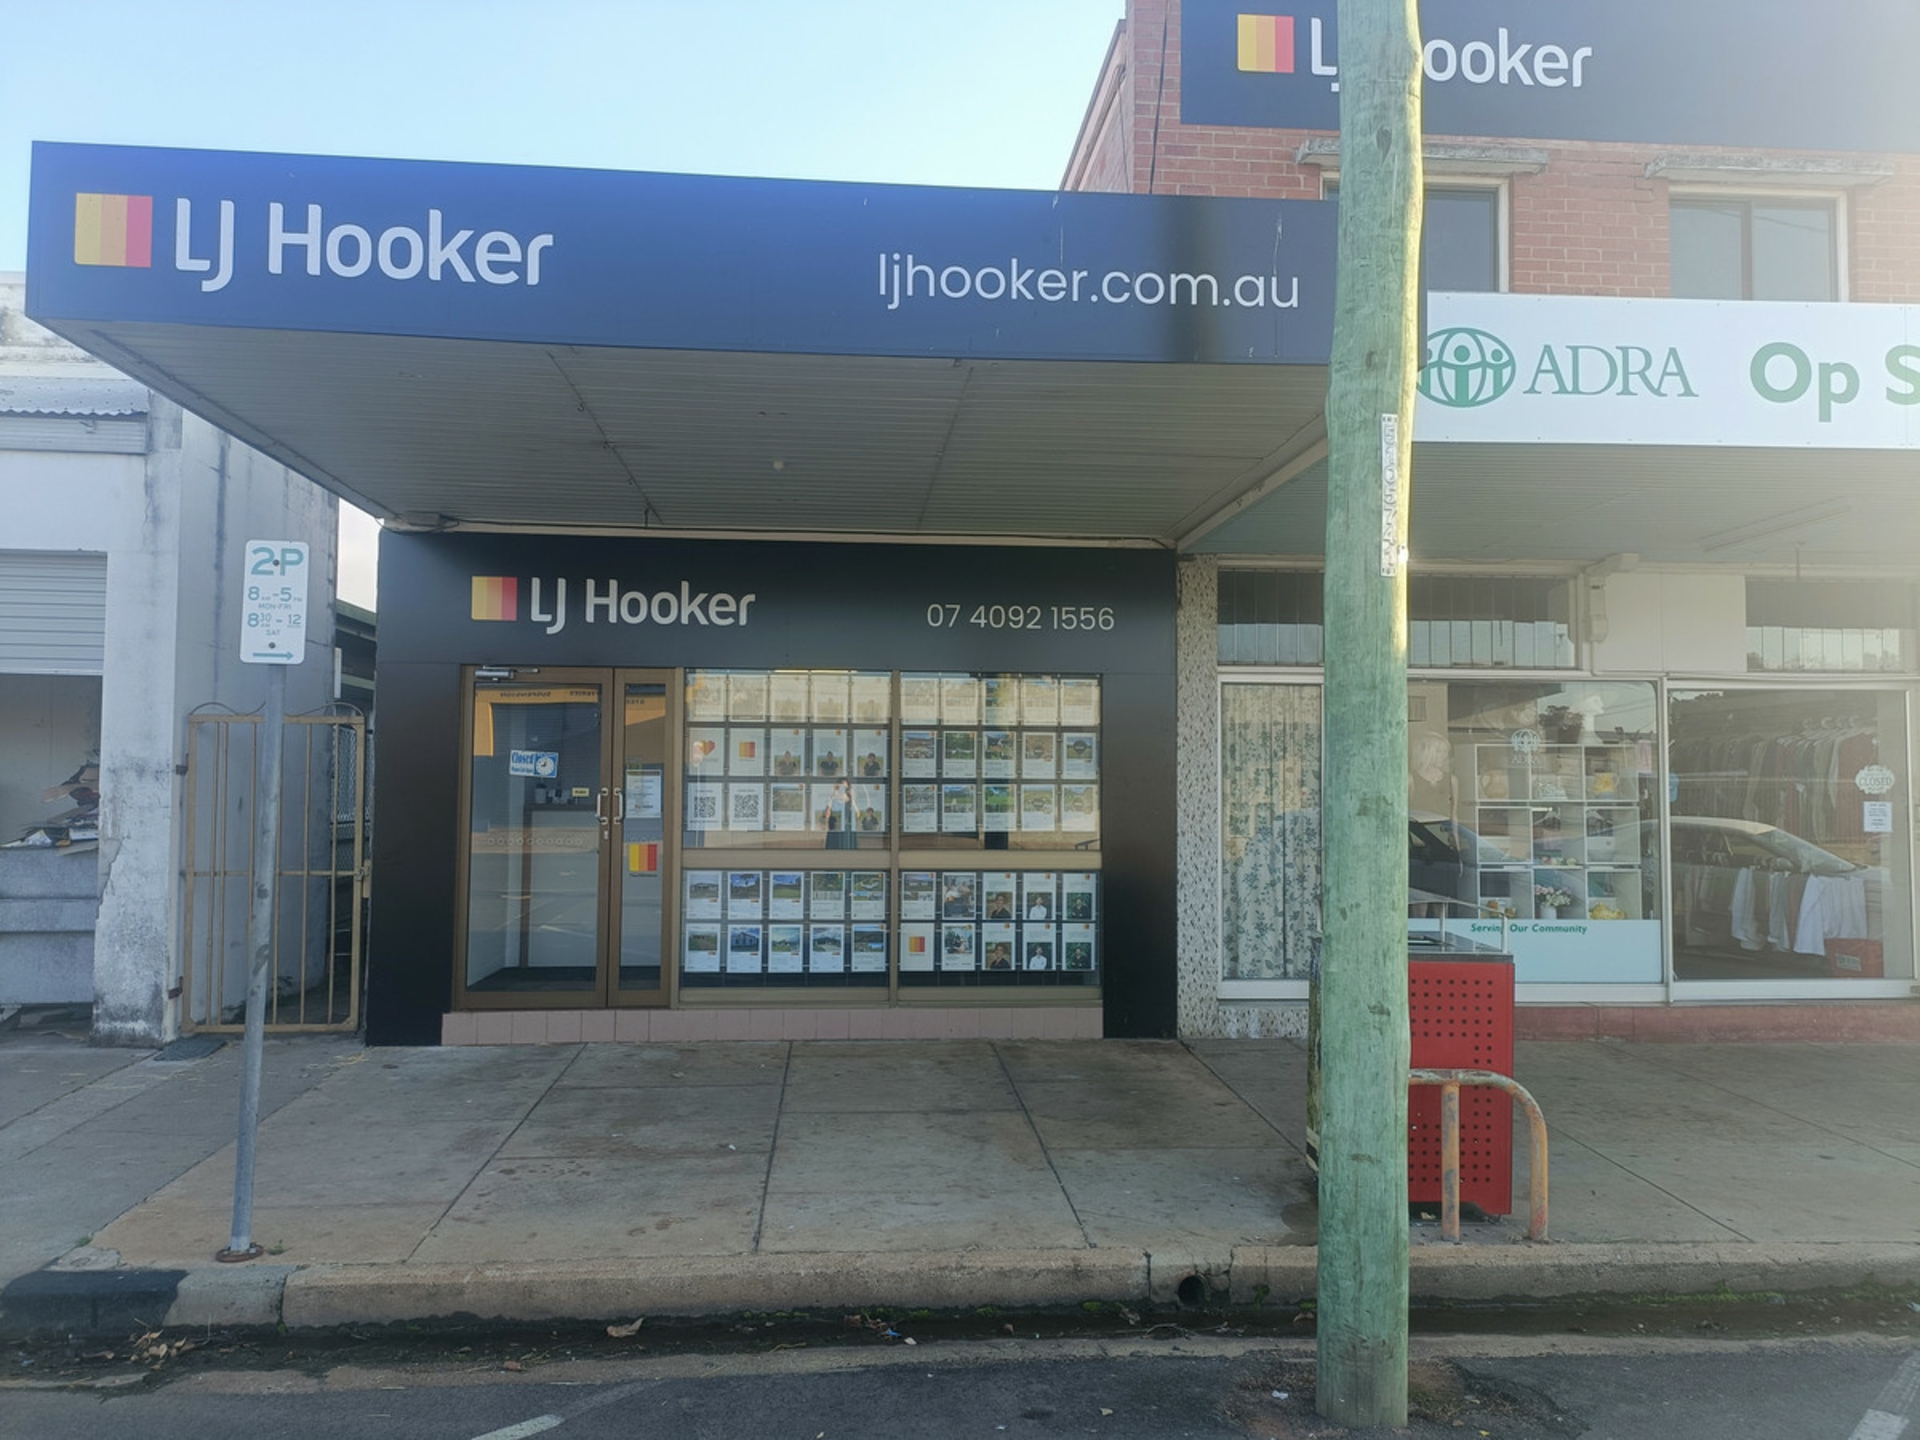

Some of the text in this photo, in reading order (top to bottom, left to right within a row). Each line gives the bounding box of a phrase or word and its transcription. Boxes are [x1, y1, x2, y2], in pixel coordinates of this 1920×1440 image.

[1310, 17, 1592, 92] L ooker
[175, 197, 554, 292] LJ Hooker
[878, 253, 1299, 310] ljhooker.com.au
[1522, 344, 1700, 398] ADRA
[1749, 341, 1860, 423] Op
[250, 546, 304, 576] 2P
[531, 577, 756, 634] LJ Hooker
[927, 604, 1115, 631] 07 4092 1556
[1509, 923, 1529, 933] Our
[1531, 923, 1588, 935] Community
